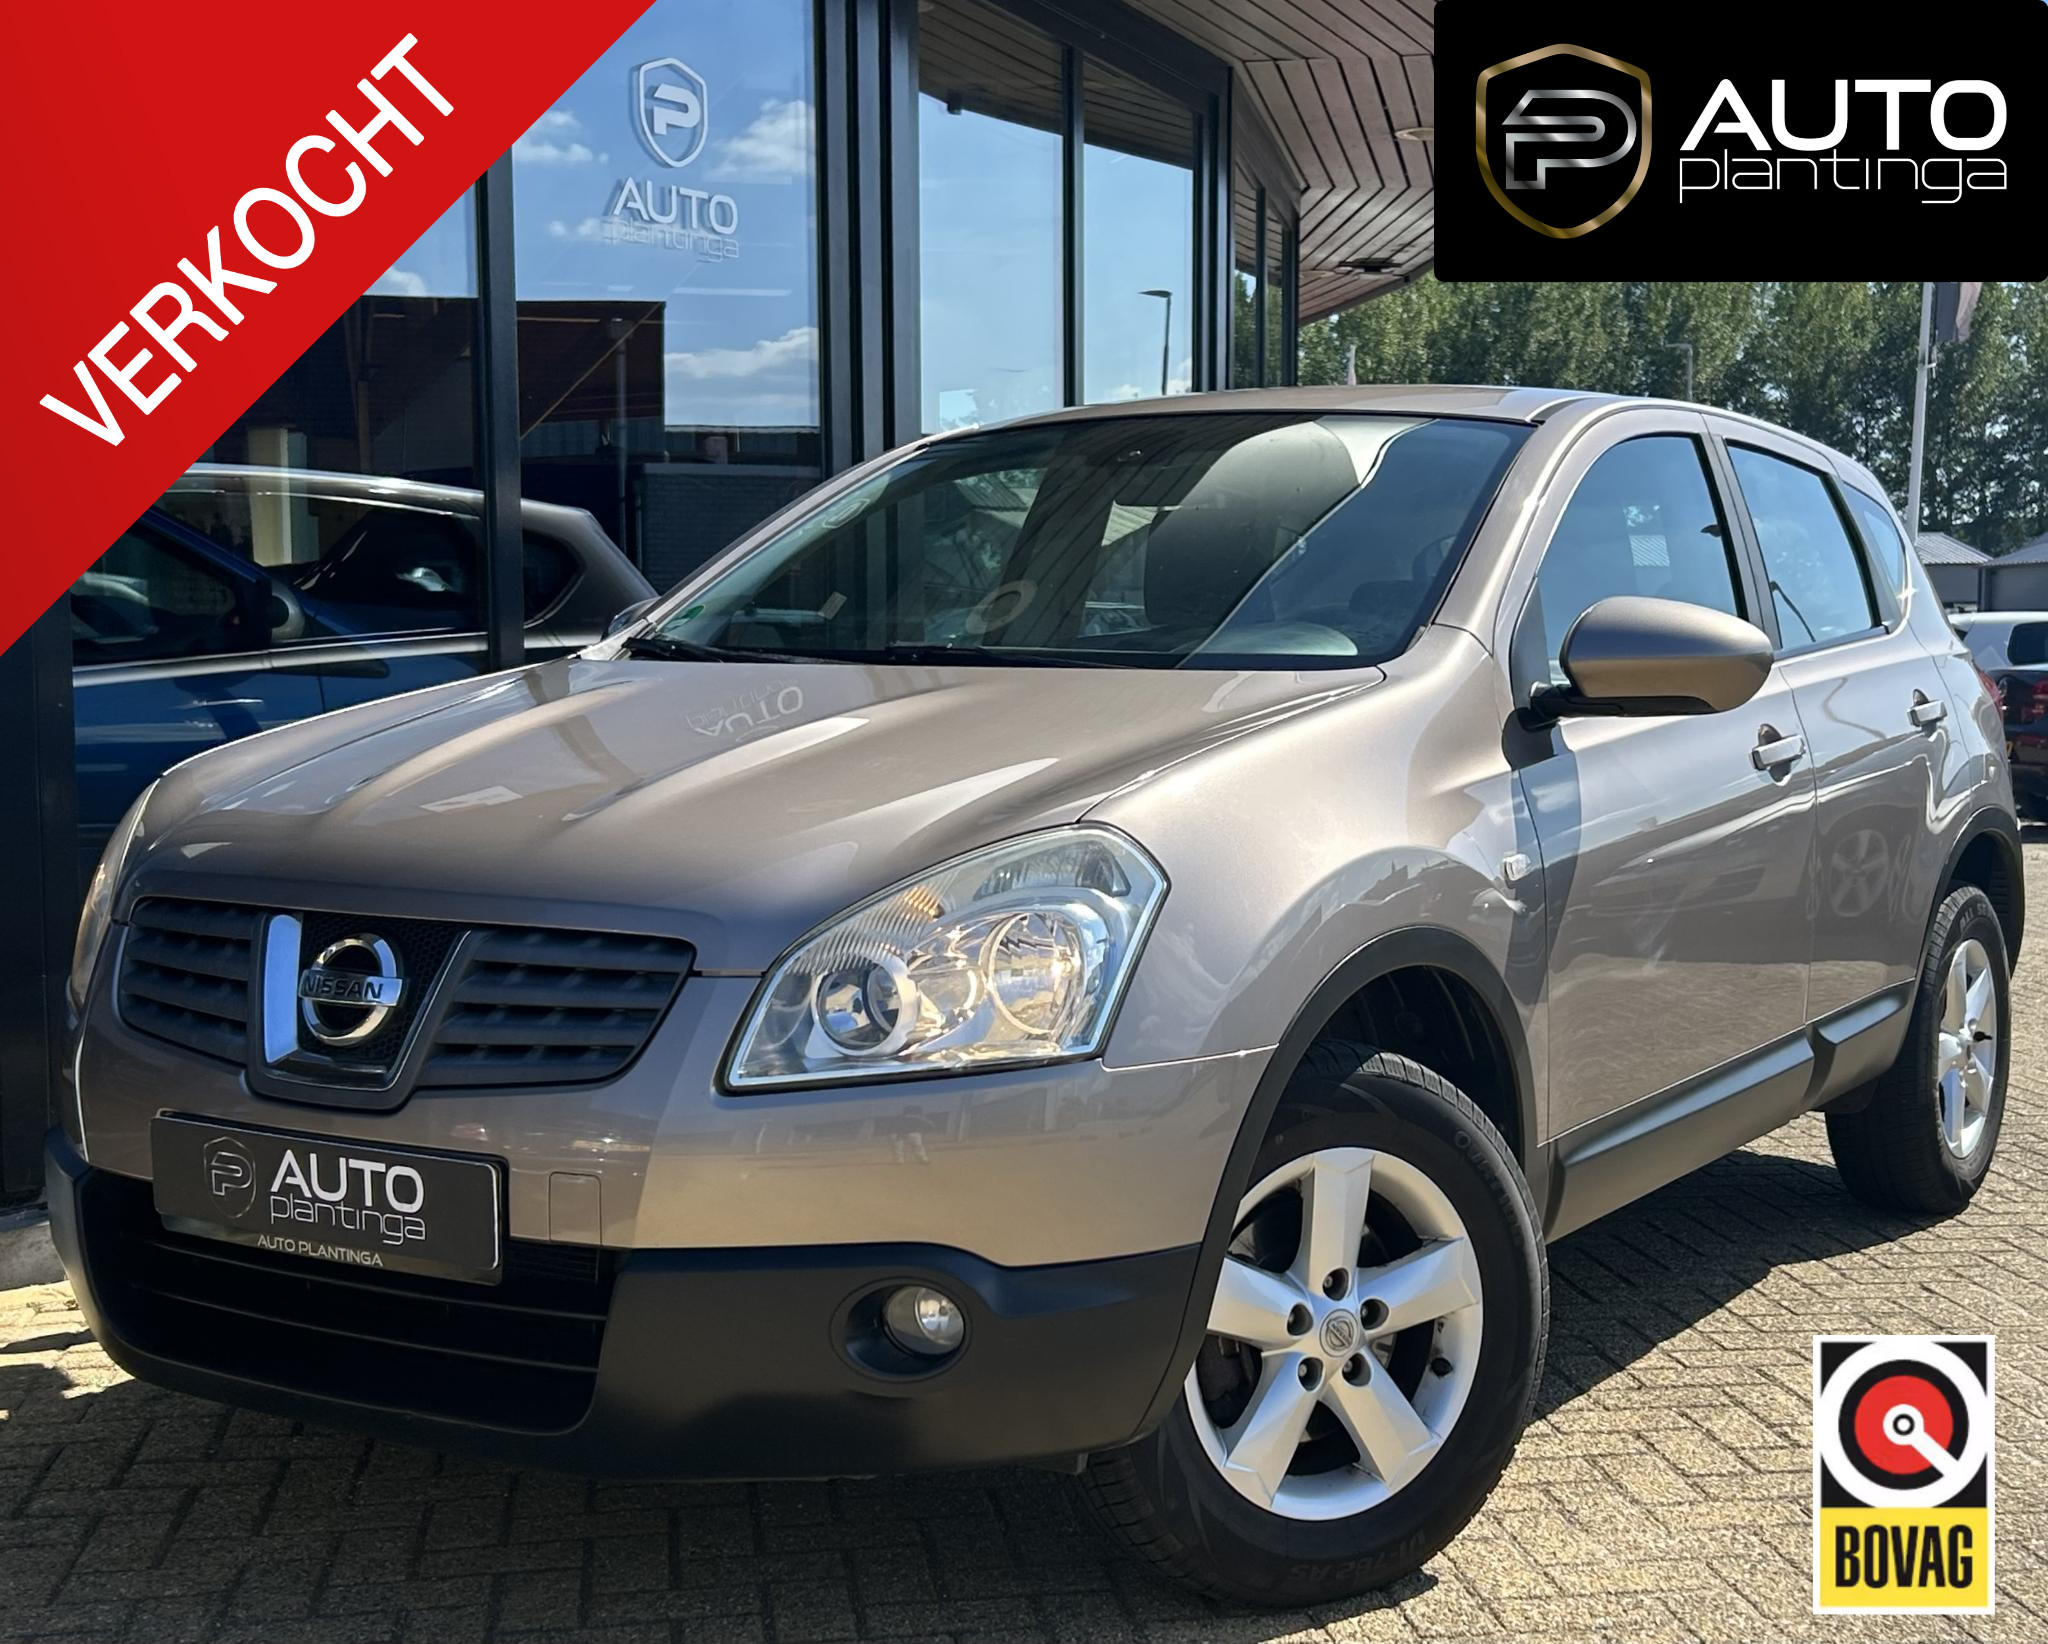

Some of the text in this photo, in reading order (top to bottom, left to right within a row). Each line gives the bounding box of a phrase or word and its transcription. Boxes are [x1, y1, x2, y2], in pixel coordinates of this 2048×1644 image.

[613, 176, 738, 235] AUTO
[611, 216, 739, 263] plantinga
[303, 974, 384, 1000] NISSAN
[270, 1149, 425, 1214] AUTO
[270, 1193, 426, 1245] plantinga
[257, 1234, 383, 1267] AUTO PLANTINGA
